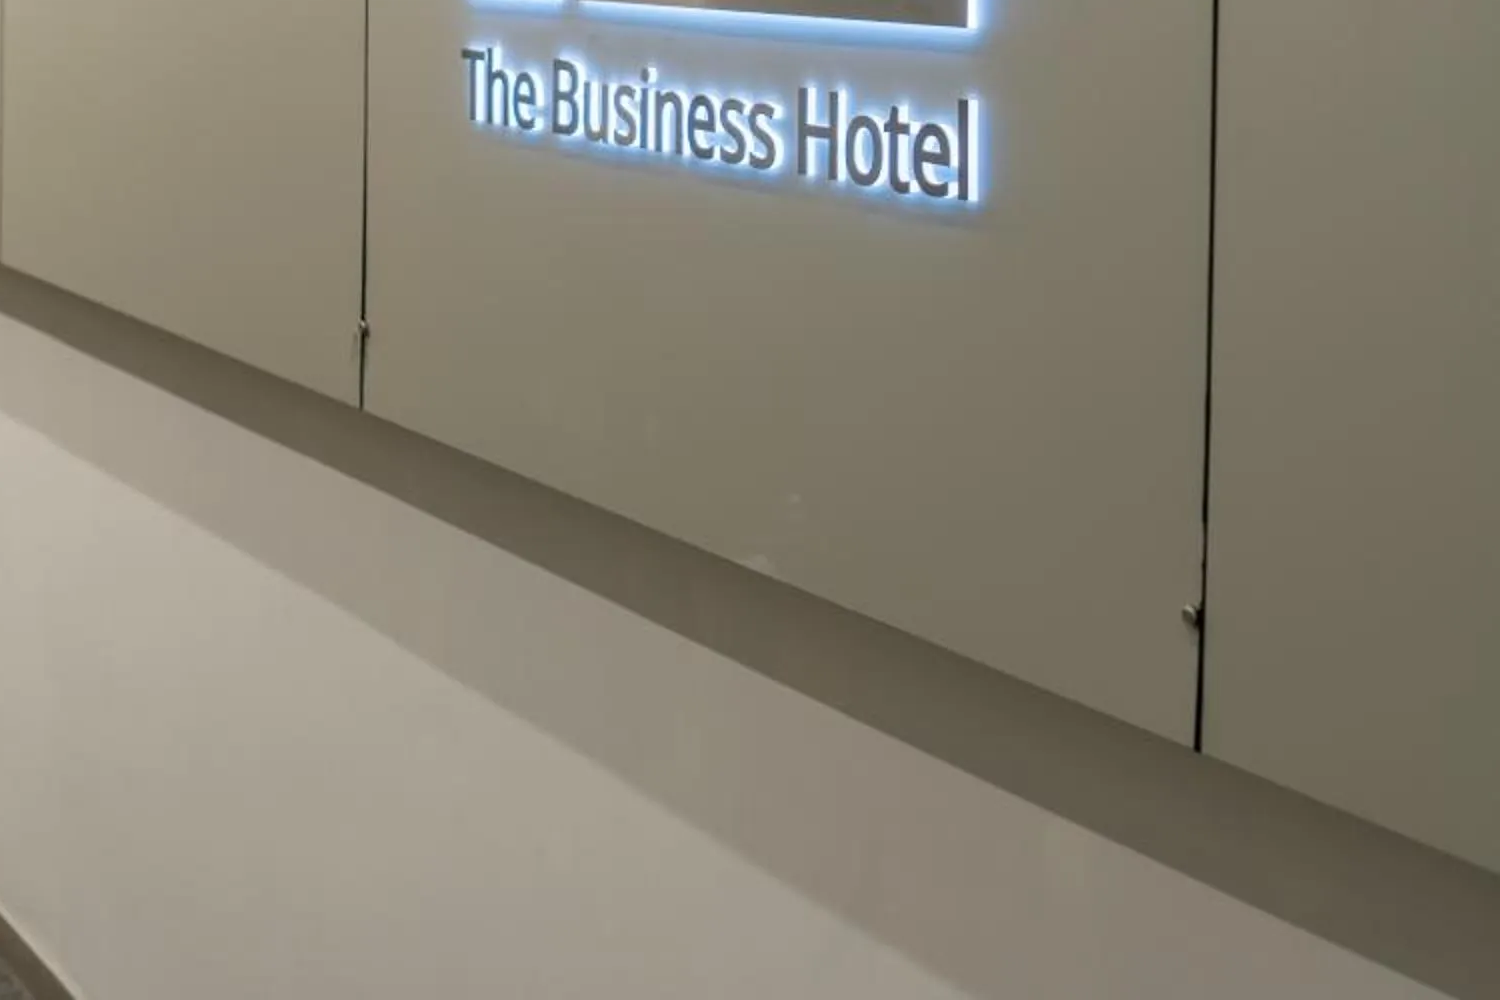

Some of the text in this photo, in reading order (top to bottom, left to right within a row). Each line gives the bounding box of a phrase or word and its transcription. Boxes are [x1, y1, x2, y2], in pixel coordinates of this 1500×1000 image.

[461, 47, 977, 201] The Business Hotel
